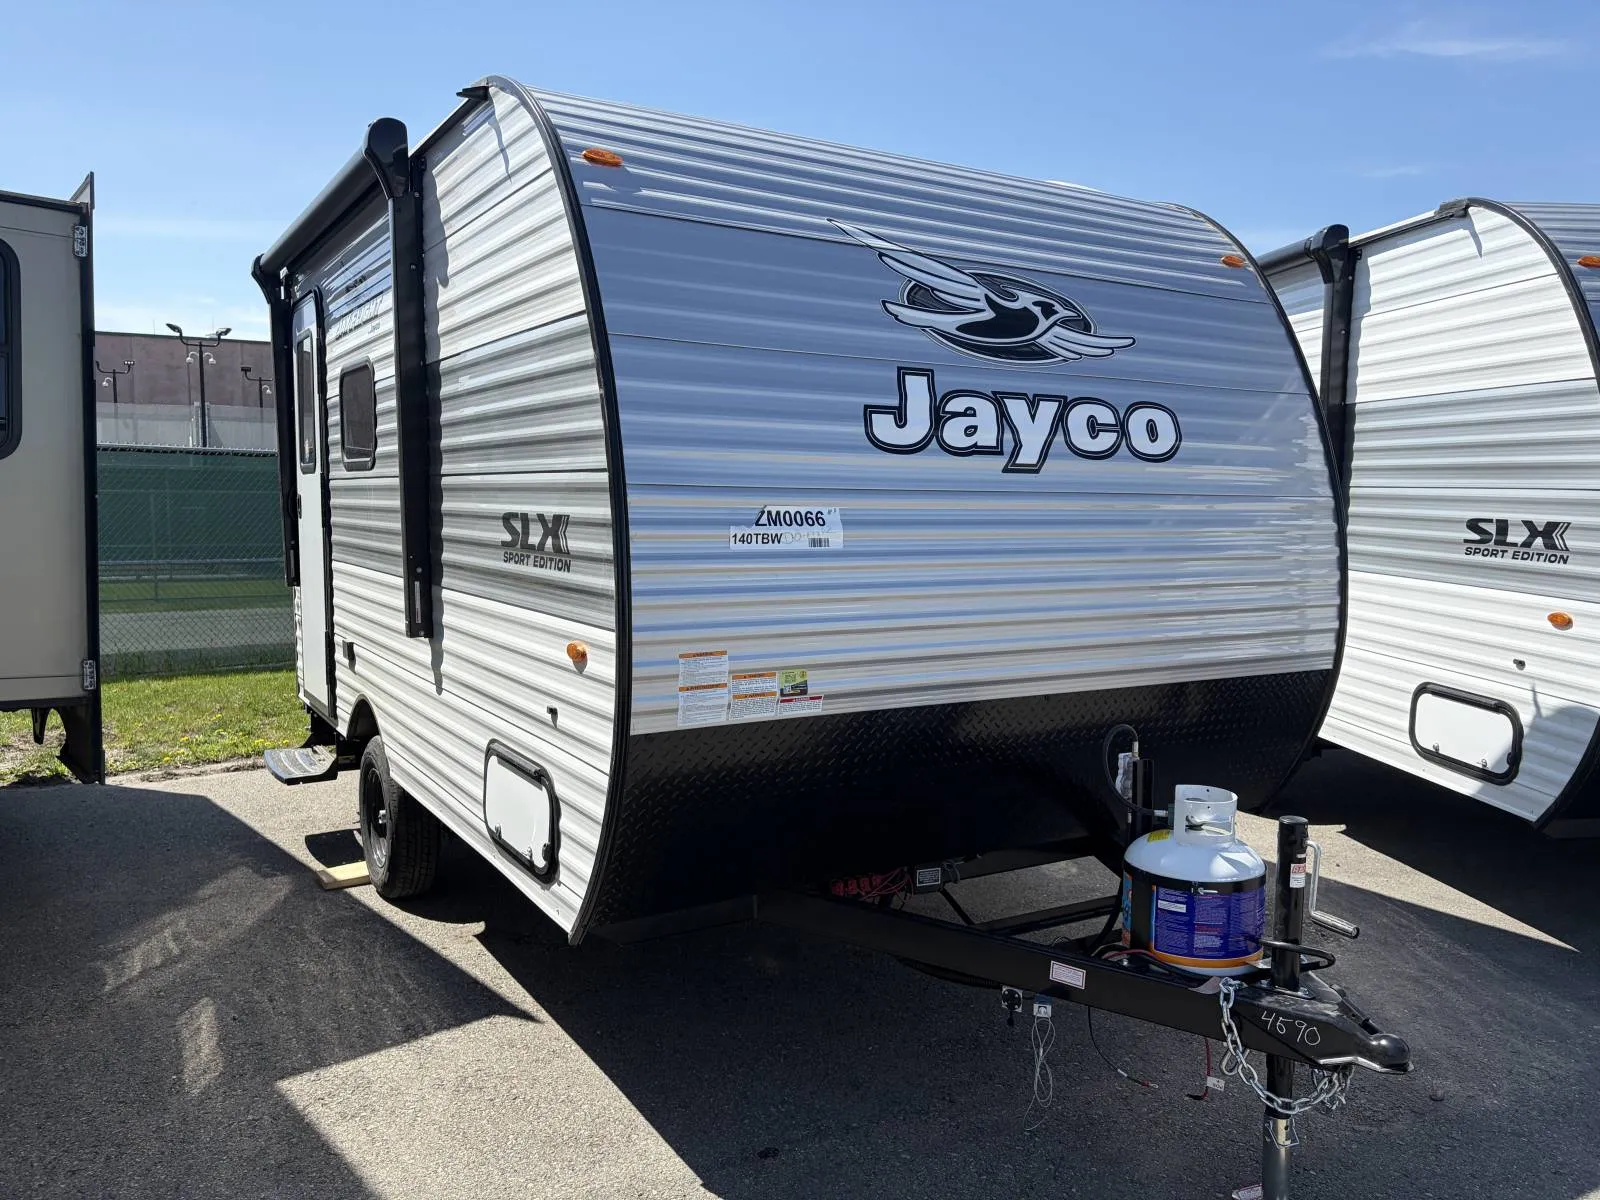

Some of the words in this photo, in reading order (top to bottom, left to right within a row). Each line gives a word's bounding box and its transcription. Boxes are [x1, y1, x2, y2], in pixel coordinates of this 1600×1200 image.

[863, 366, 1182, 474] Jayco
[501, 512, 570, 554] SLX
[731, 532, 783, 545] 140TBW
[1463, 518, 1572, 551] SLX
[503, 551, 531, 566] SPORT
[533, 555, 571, 573] EDITION
[1464, 546, 1508, 559] SPORT
[1511, 550, 1570, 565] EDITION
[1261, 1010, 1321, 1046] 4590
